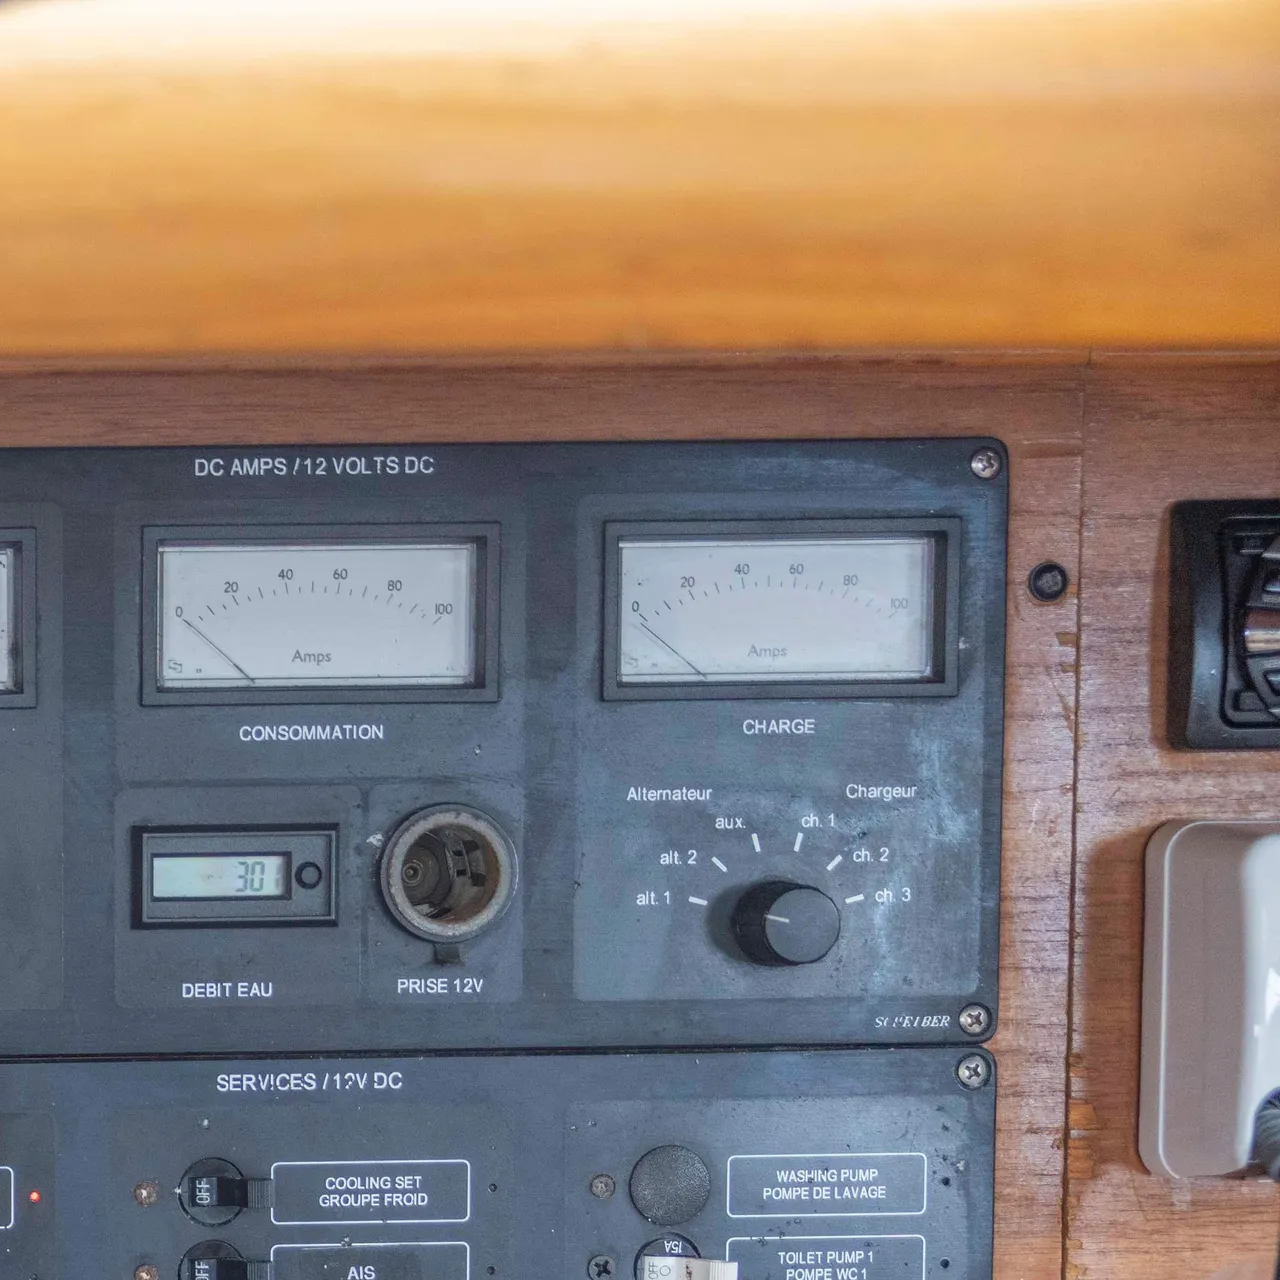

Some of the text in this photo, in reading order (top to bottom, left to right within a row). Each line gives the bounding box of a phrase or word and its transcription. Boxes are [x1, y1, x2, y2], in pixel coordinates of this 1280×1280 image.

[195, 459, 223, 476] DC
[231, 458, 286, 475] AMPS
[333, 457, 399, 474] VOLTS
[405, 456, 434, 473] DC
[748, 644, 787, 657] Amps
[292, 650, 331, 666] Amps
[240, 725, 383, 741] CONSOMMATION
[743, 719, 815, 734] CHARGE
[627, 787, 712, 801] Alternateur
[846, 784, 917, 801] Chargeur
[716, 818, 746, 829] aux.
[853, 848, 889, 862] ch. 2
[875, 887, 911, 905] ch. 3
[183, 983, 272, 997] DEBIT EAU
[398, 978, 483, 993] PRISE 12V
[326, 1176, 421, 1189] COOLING SET
[319, 1193, 428, 1206] GROUPE FROID
[778, 1251, 872, 1264] TOILET PUMP 1
[348, 1266, 375, 1280] AIS
[648, 1261, 658, 1279] OFF
[787, 1268, 866, 1280] POMPE WC 1
